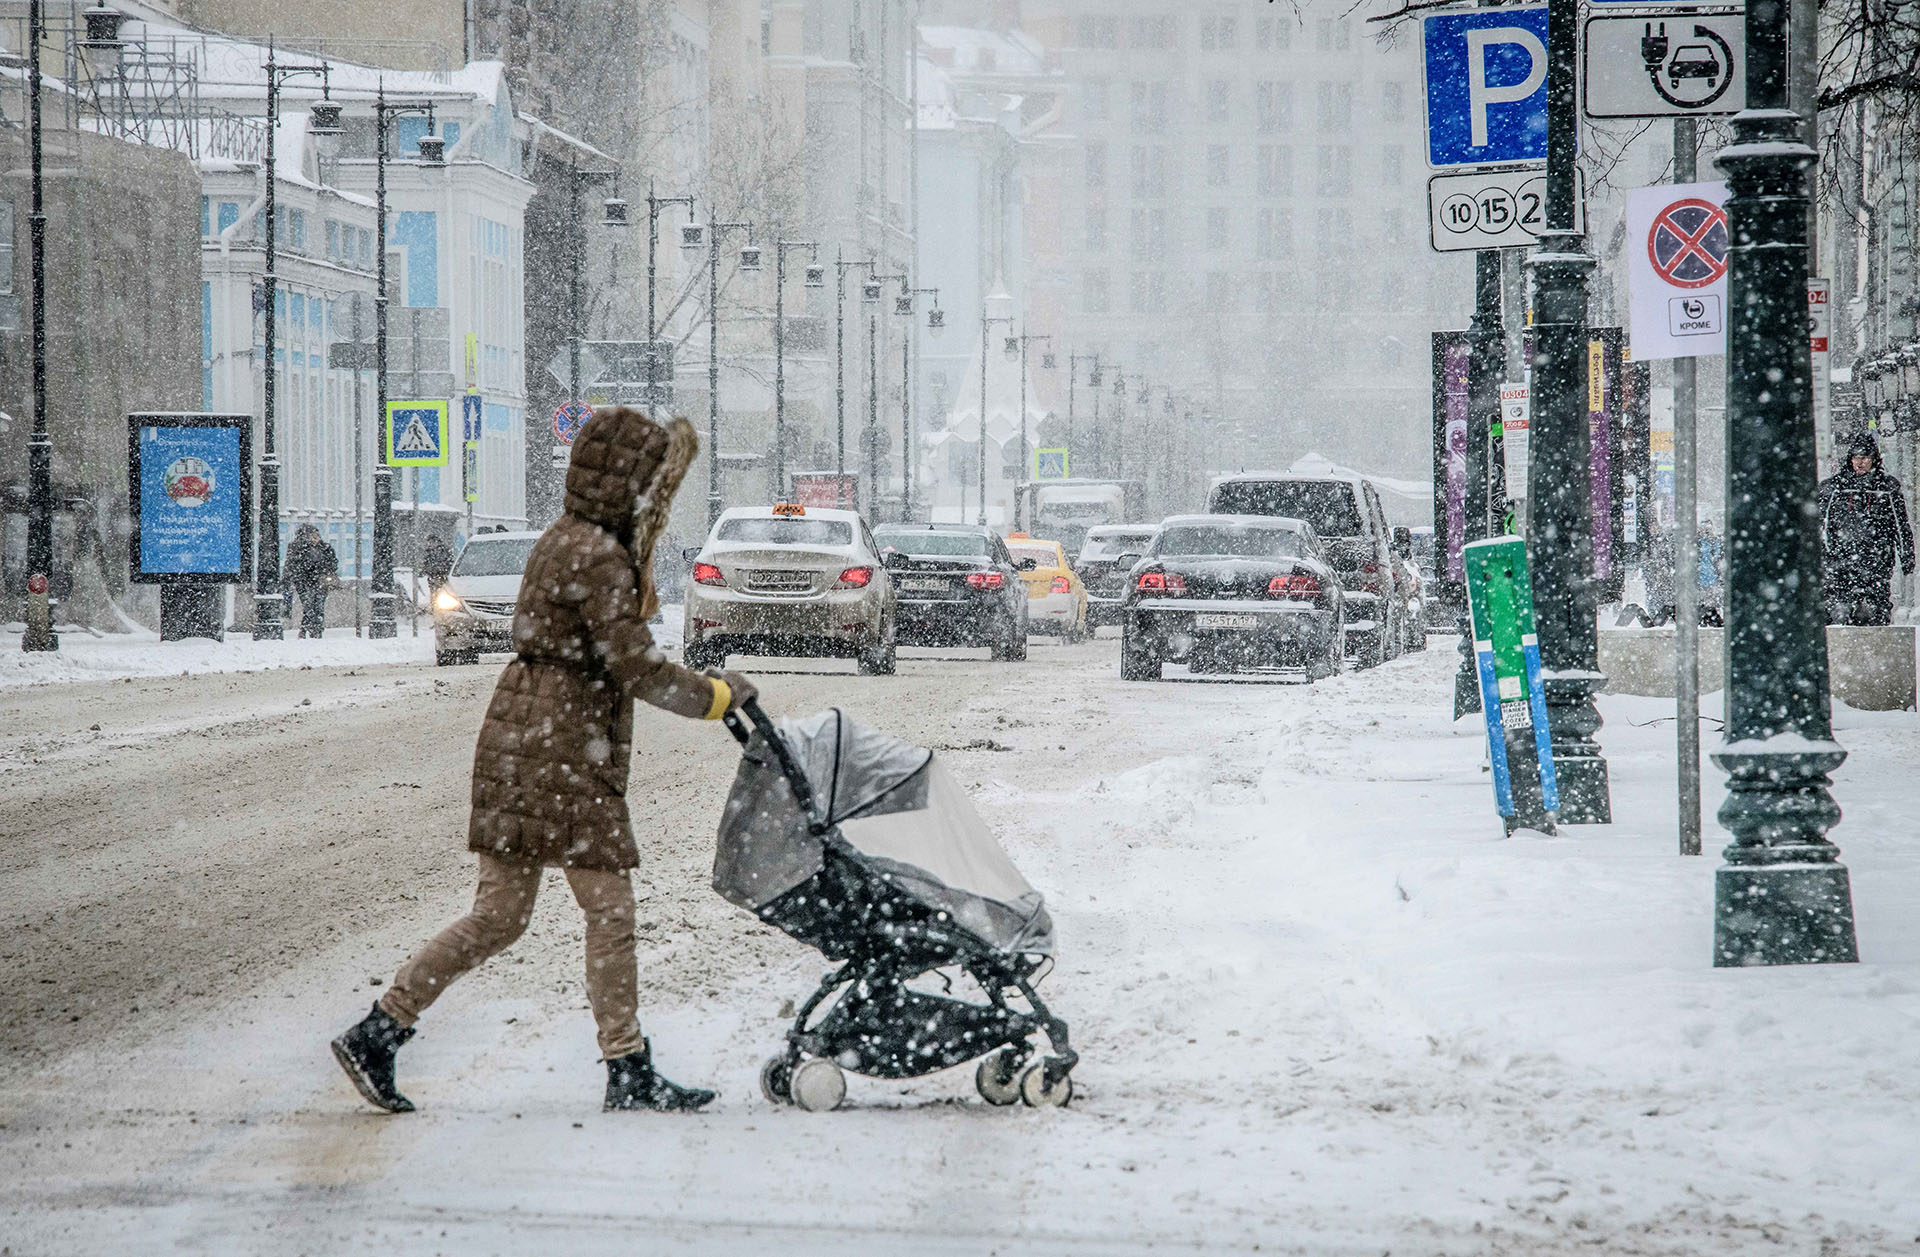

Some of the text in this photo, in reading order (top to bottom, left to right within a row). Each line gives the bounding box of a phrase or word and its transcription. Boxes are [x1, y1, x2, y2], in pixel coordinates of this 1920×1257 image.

[1467, 27, 1548, 146] P
[1449, 193, 1541, 224] 10 15 2
[1808, 291, 1827, 303] 04
[1680, 321, 1711, 329] КРОМЕ
[1504, 391, 1529, 400] 0304
